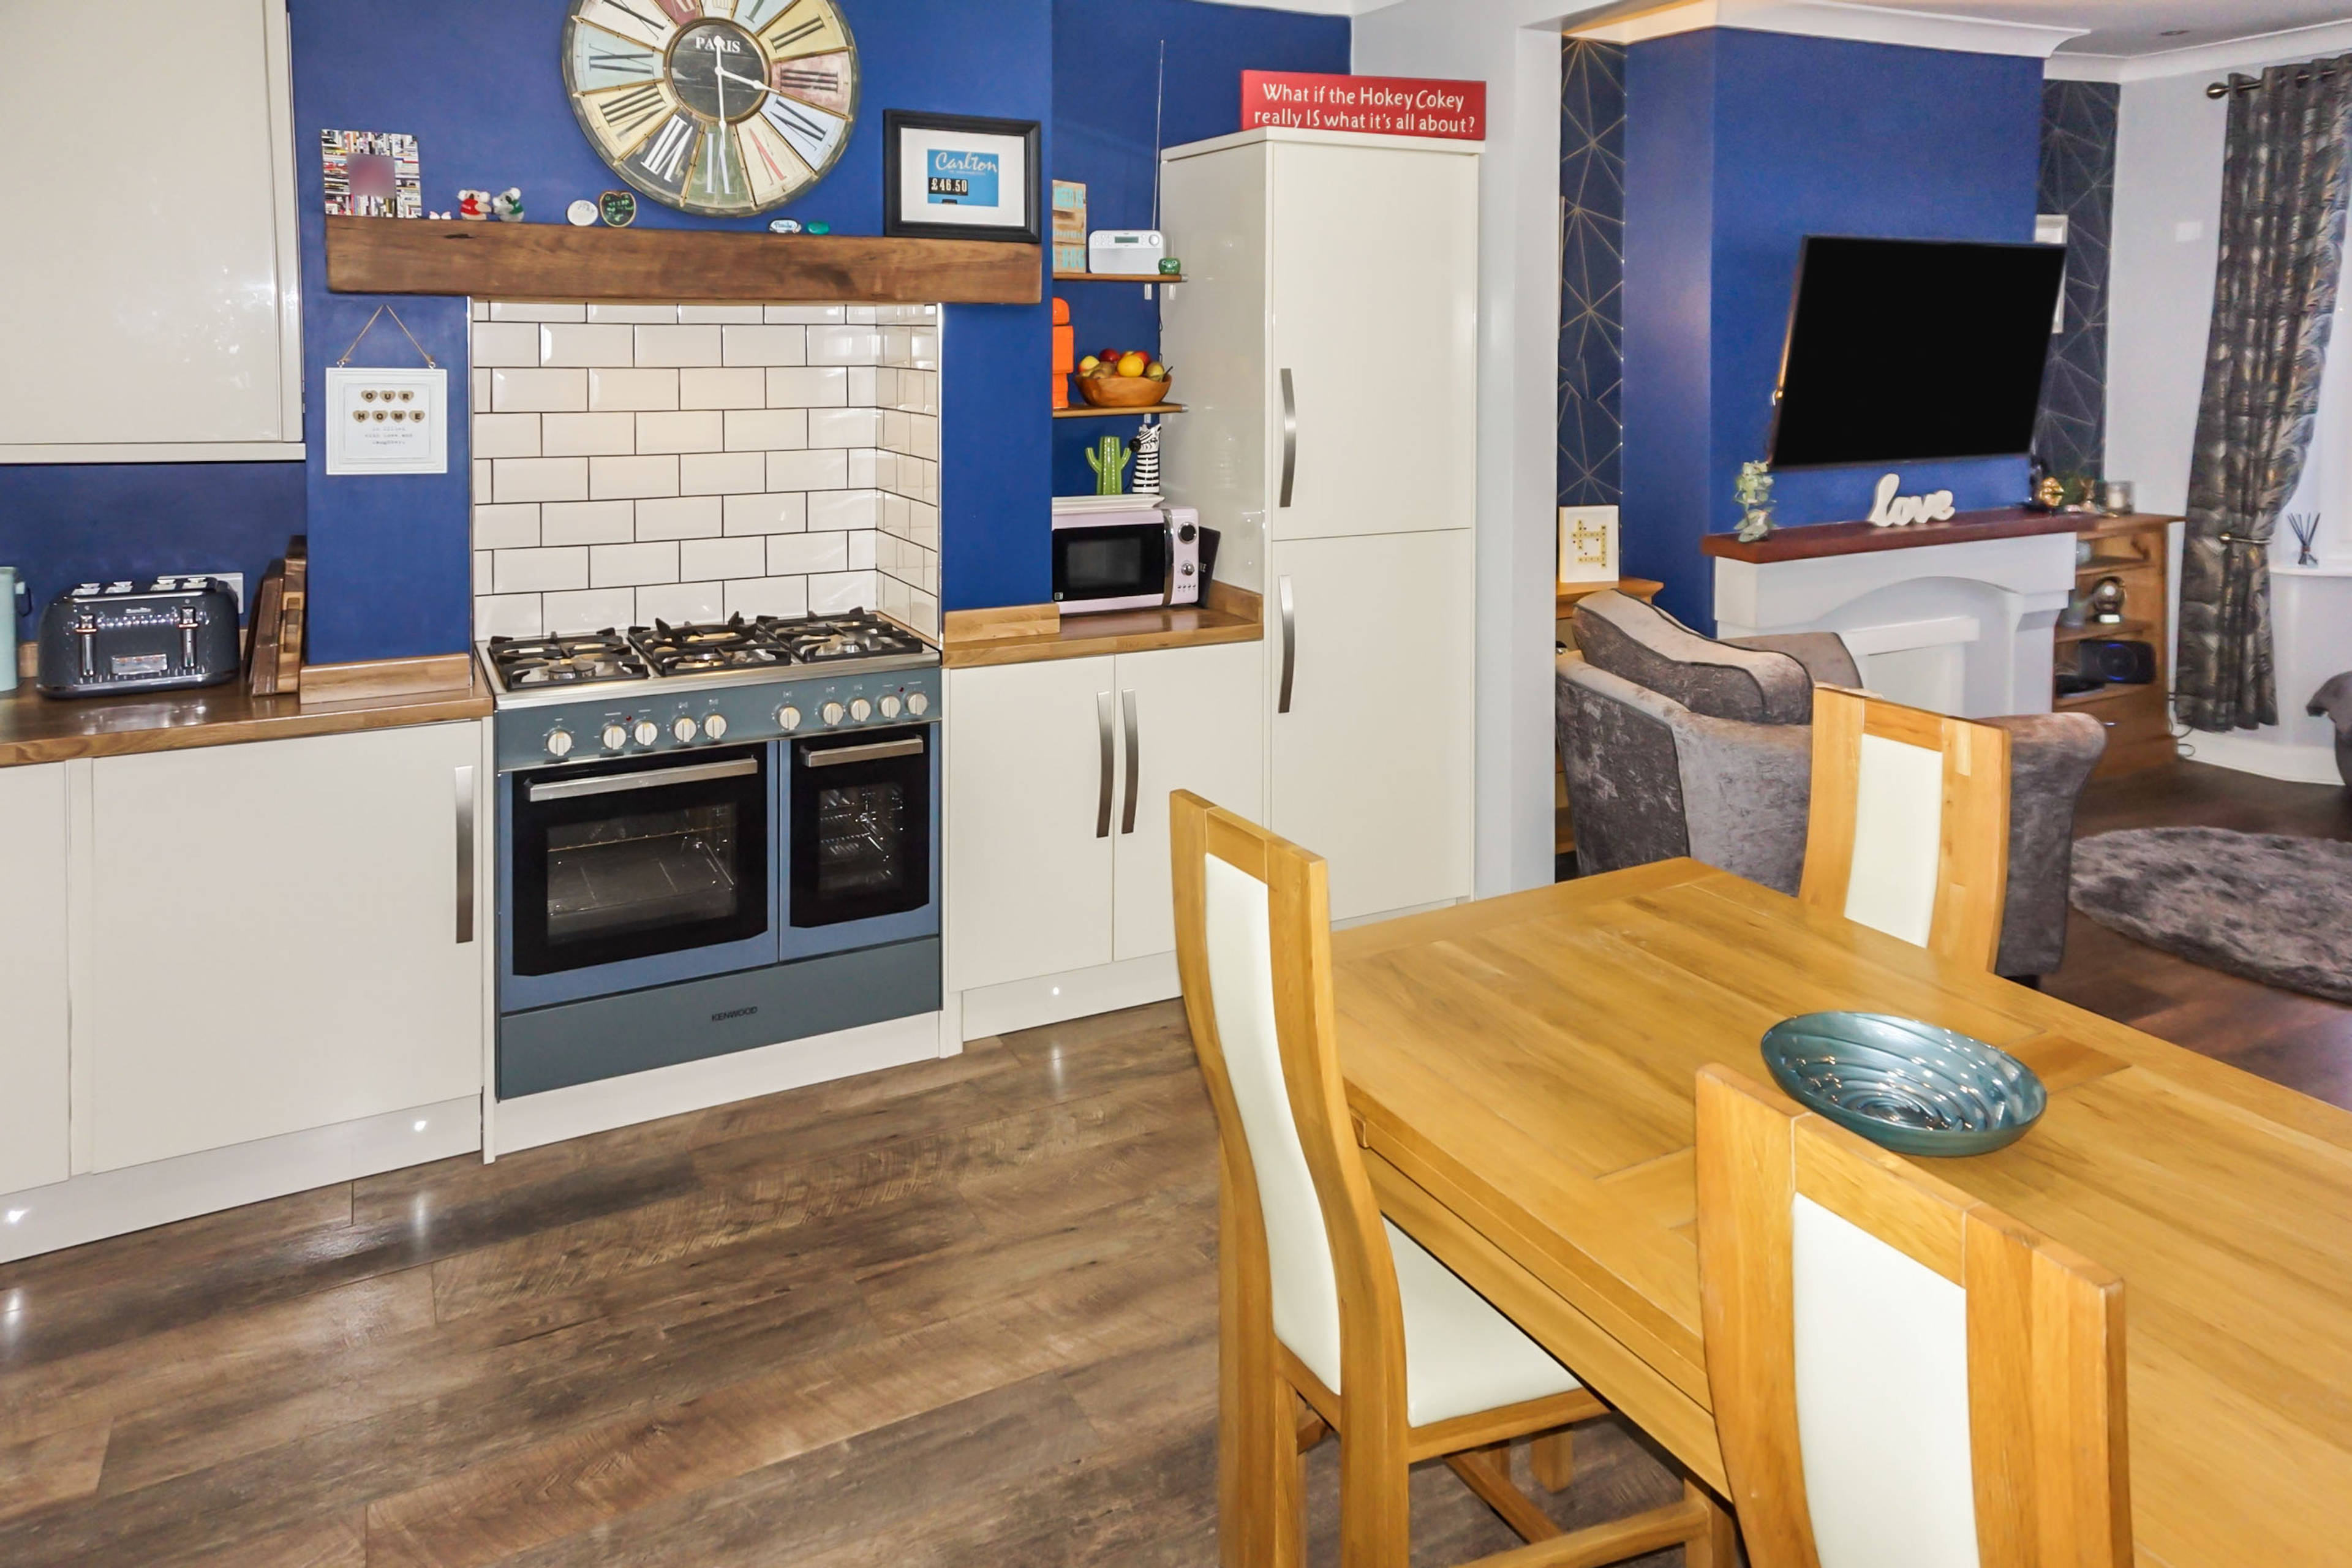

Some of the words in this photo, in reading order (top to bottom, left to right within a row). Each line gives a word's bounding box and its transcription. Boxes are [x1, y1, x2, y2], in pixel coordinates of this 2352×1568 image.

[695, 37, 741, 53] PARIS
[1263, 83, 1309, 102] What
[1314, 86, 1325, 104] if
[1329, 88, 1355, 105] the
[1360, 87, 1413, 110] Hokey
[1415, 90, 1464, 113] Cokey
[1254, 109, 1302, 129] really
[1307, 109, 1320, 127] IS
[1324, 110, 1366, 129] what
[1370, 113, 1391, 129] it's
[1396, 111, 1415, 131] all
[1419, 116, 1475, 133] about?
[935, 152, 997, 173] Carlton
[931, 178, 968, 192] £46.50
[1869, 473, 1955, 527] love
[711, 1006, 758, 1022] KENWOOD
